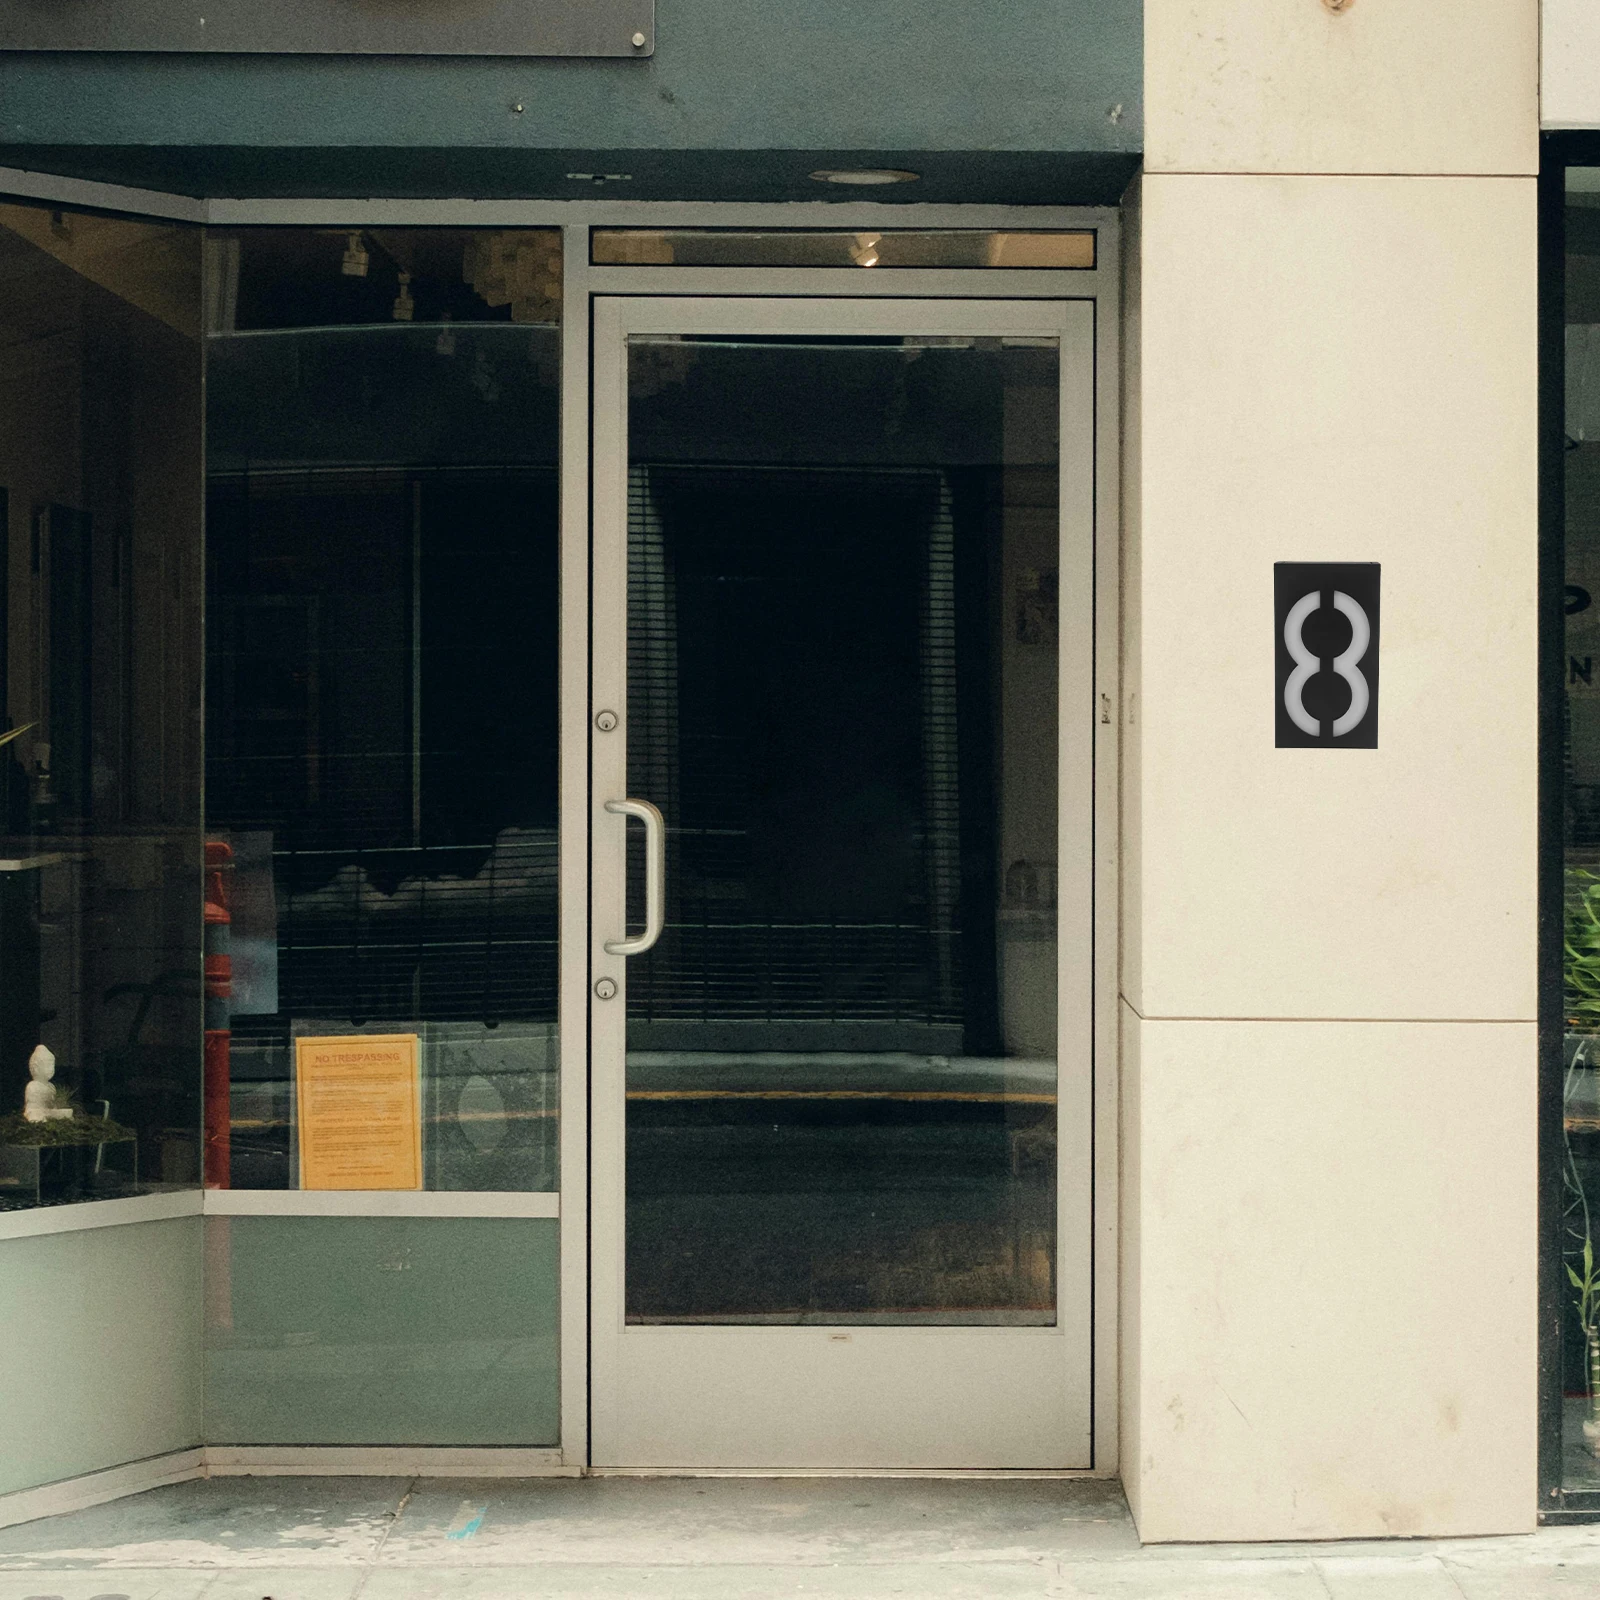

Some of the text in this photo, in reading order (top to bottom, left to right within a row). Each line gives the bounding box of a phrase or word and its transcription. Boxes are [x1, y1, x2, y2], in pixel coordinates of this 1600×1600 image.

[1284, 590, 1370, 737] 8
[315, 1052, 400, 1063] NO TRESPASSING
